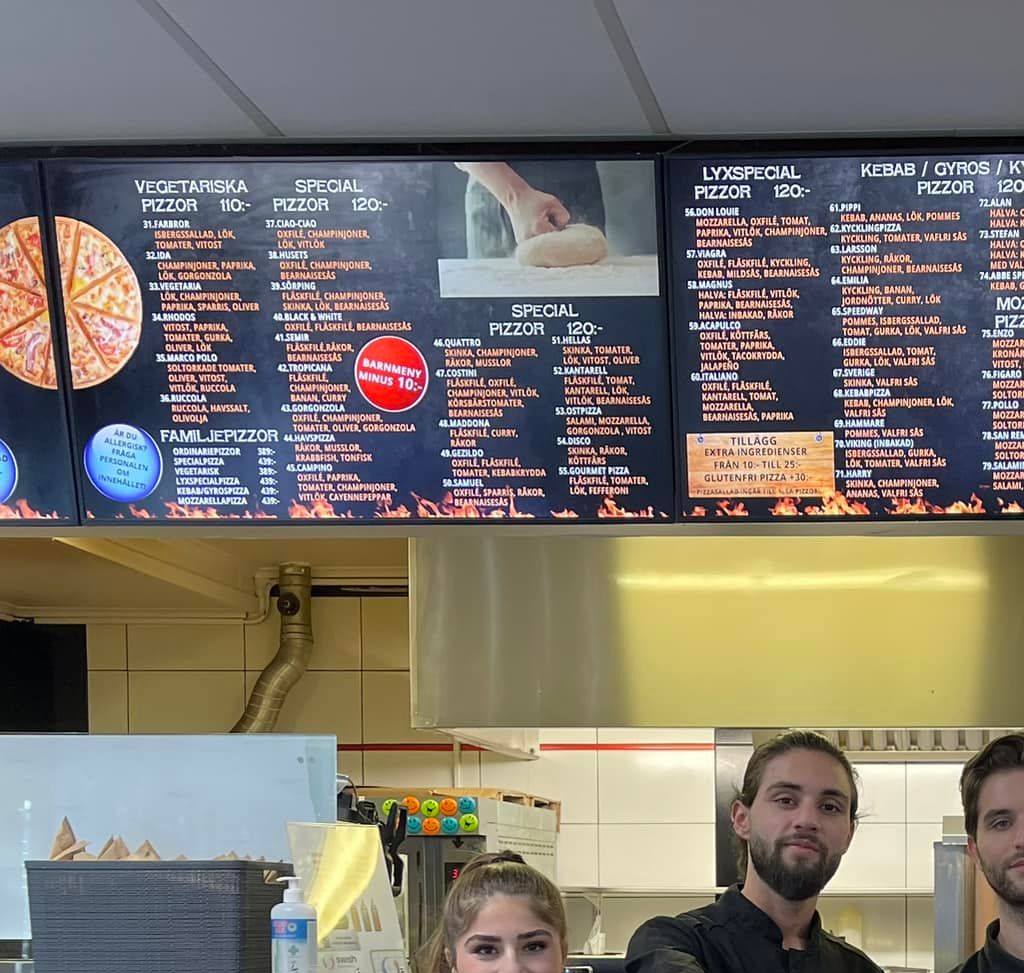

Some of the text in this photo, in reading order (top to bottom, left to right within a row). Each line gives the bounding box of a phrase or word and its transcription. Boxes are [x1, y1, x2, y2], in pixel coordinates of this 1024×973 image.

[703, 166, 801, 181] LYXSPECIAL
[861, 163, 915, 177] KEBAB
[935, 161, 990, 176] GYROS
[135, 180, 248, 194] VEGETARISKA
[295, 179, 363, 193] SPECIAL
[694, 184, 811, 199] PIZZOR 120:-
[917, 181, 974, 195] PIZZOR
[142, 199, 251, 212] PIZZOR 110:-
[273, 199, 387, 212] PIZZOR 120:-
[926, 212, 960, 221] POMMES
[512, 304, 578, 318] SPECIAL
[490, 322, 603, 336] PIZZOR 120:-
[363, 358, 422, 378] BARNMENY
[359, 372, 422, 391] MINUS 10:-
[160, 429, 278, 442] FAMILJEPIZZOR
[731, 436, 777, 447] TILLÄGG
[704, 447, 807, 456] EXTRA INGREDIENSER
[714, 459, 740, 469] FRÅN
[762, 461, 782, 469] TILL
[704, 473, 756, 482] GLUTENFRI
[760, 473, 787, 482] PIZZA
